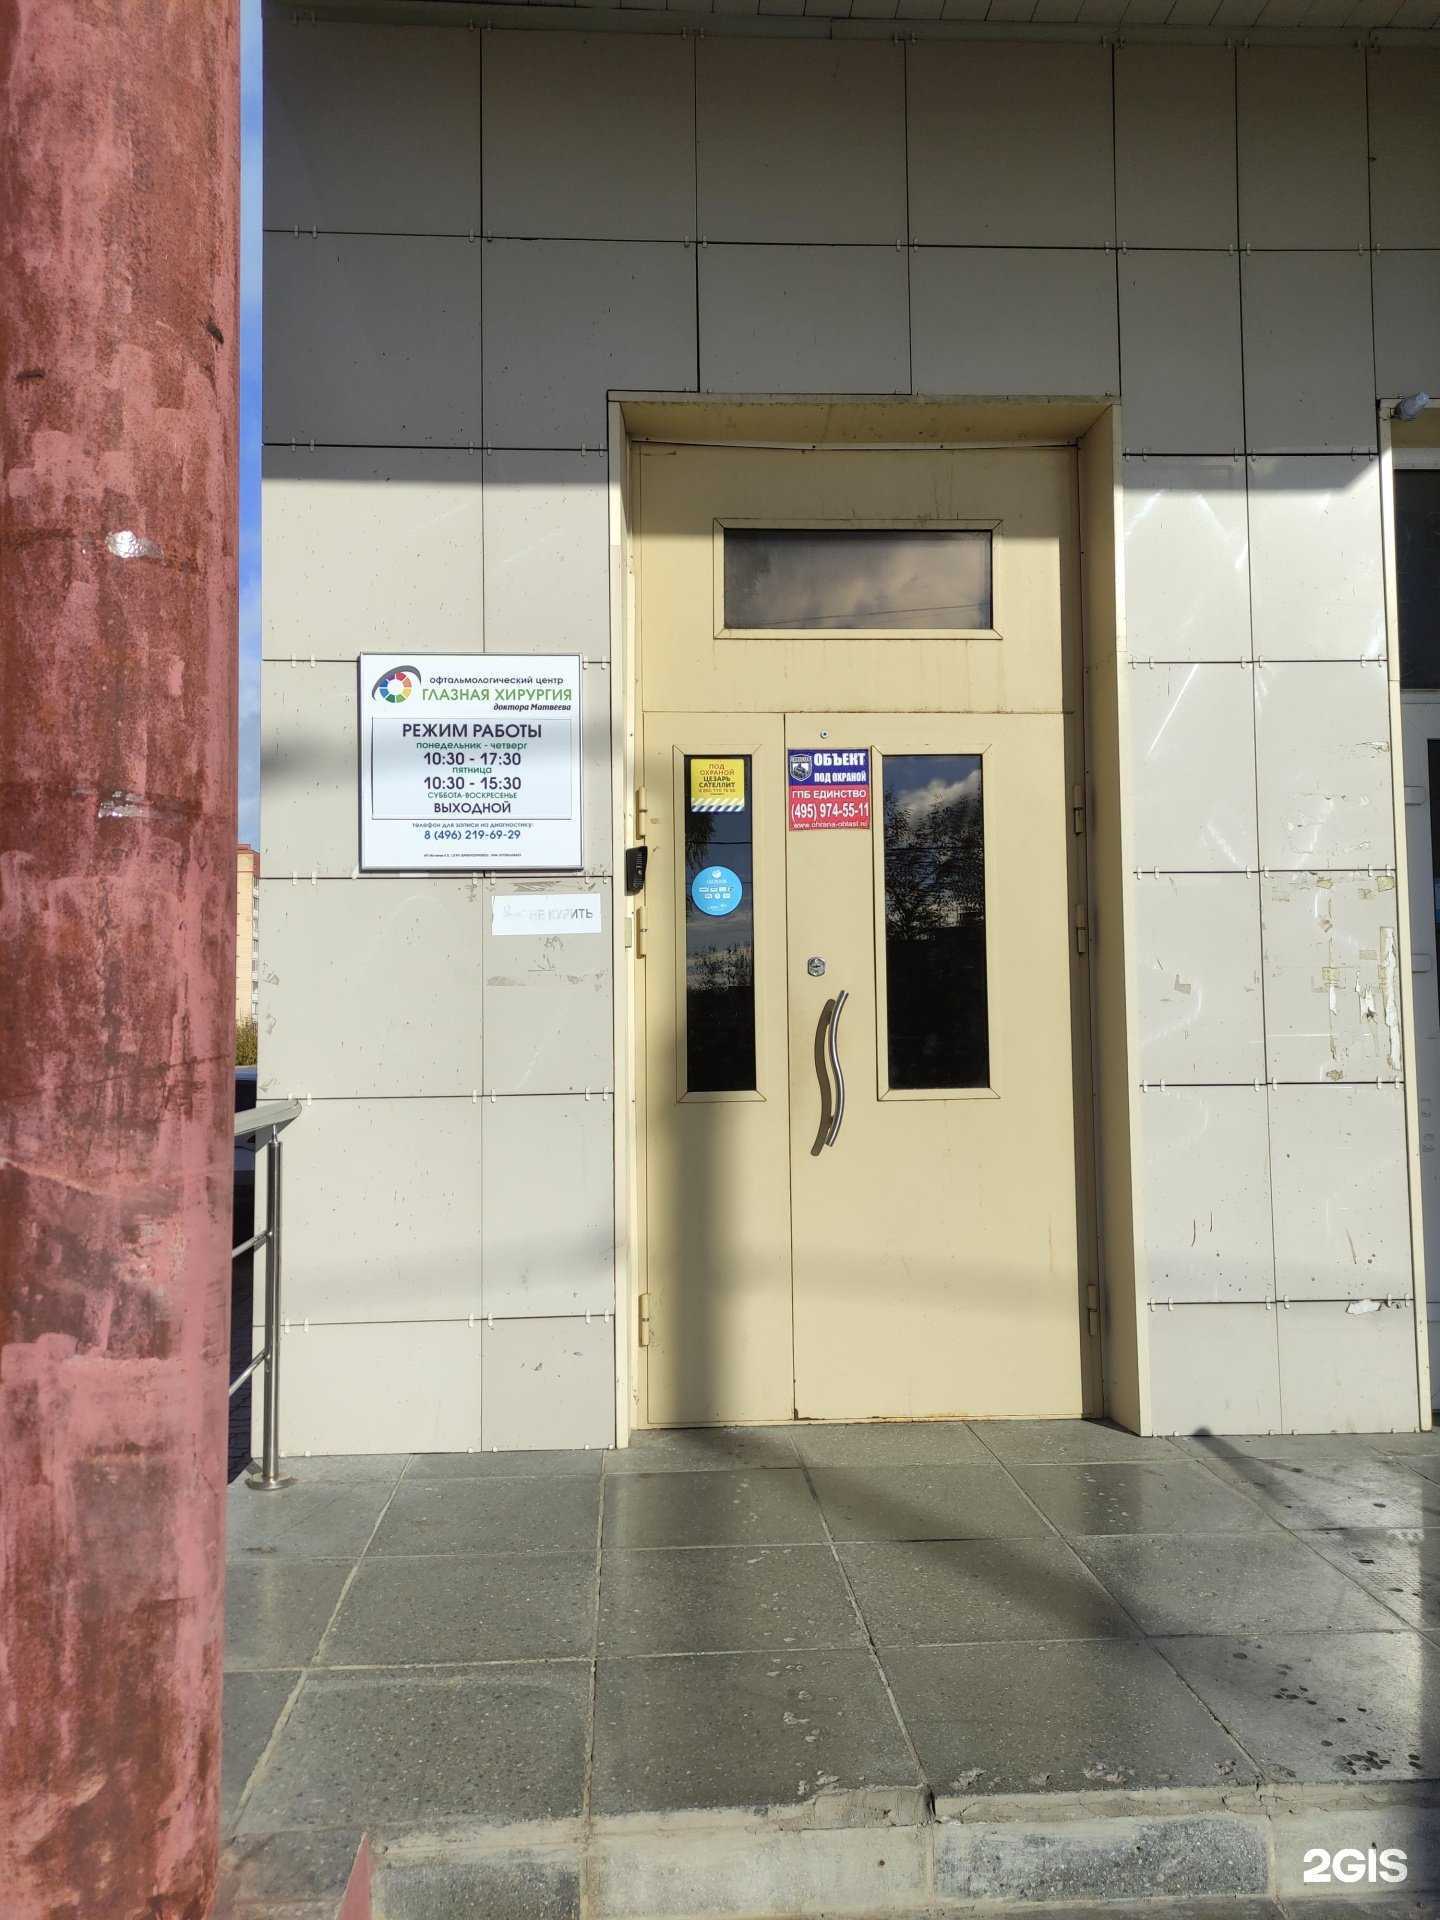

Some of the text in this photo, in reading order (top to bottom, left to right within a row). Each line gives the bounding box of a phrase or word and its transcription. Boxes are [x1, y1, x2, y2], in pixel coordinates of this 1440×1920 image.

[430, 676, 564, 685] офтальмологический центр
[422, 689, 572, 701] ГЛАЗНАЯ ХИРУРГИЯ
[494, 703, 571, 712] доктора Матвеева
[402, 724, 542, 738] РЕЖИМ РАБОТЫ
[416, 742, 482, 750] понедельник
[490, 742, 528, 750] четверг
[424, 753, 465, 766] 10:30
[480, 753, 521, 766] 17:30
[814, 753, 866, 766] ОБЪЕКТ
[814, 771, 866, 783] ПОД ОХРАНОЙ
[424, 777, 465, 790] 10:30
[480, 777, 521, 790] 15:30
[814, 790, 866, 799] ЕДИНСТВО
[434, 801, 511, 814] ВЫХОДНОЙ
[792, 802, 869, 822] (495) 974-55-11
[424, 830, 521, 841] 8 (496) 219-69-29
